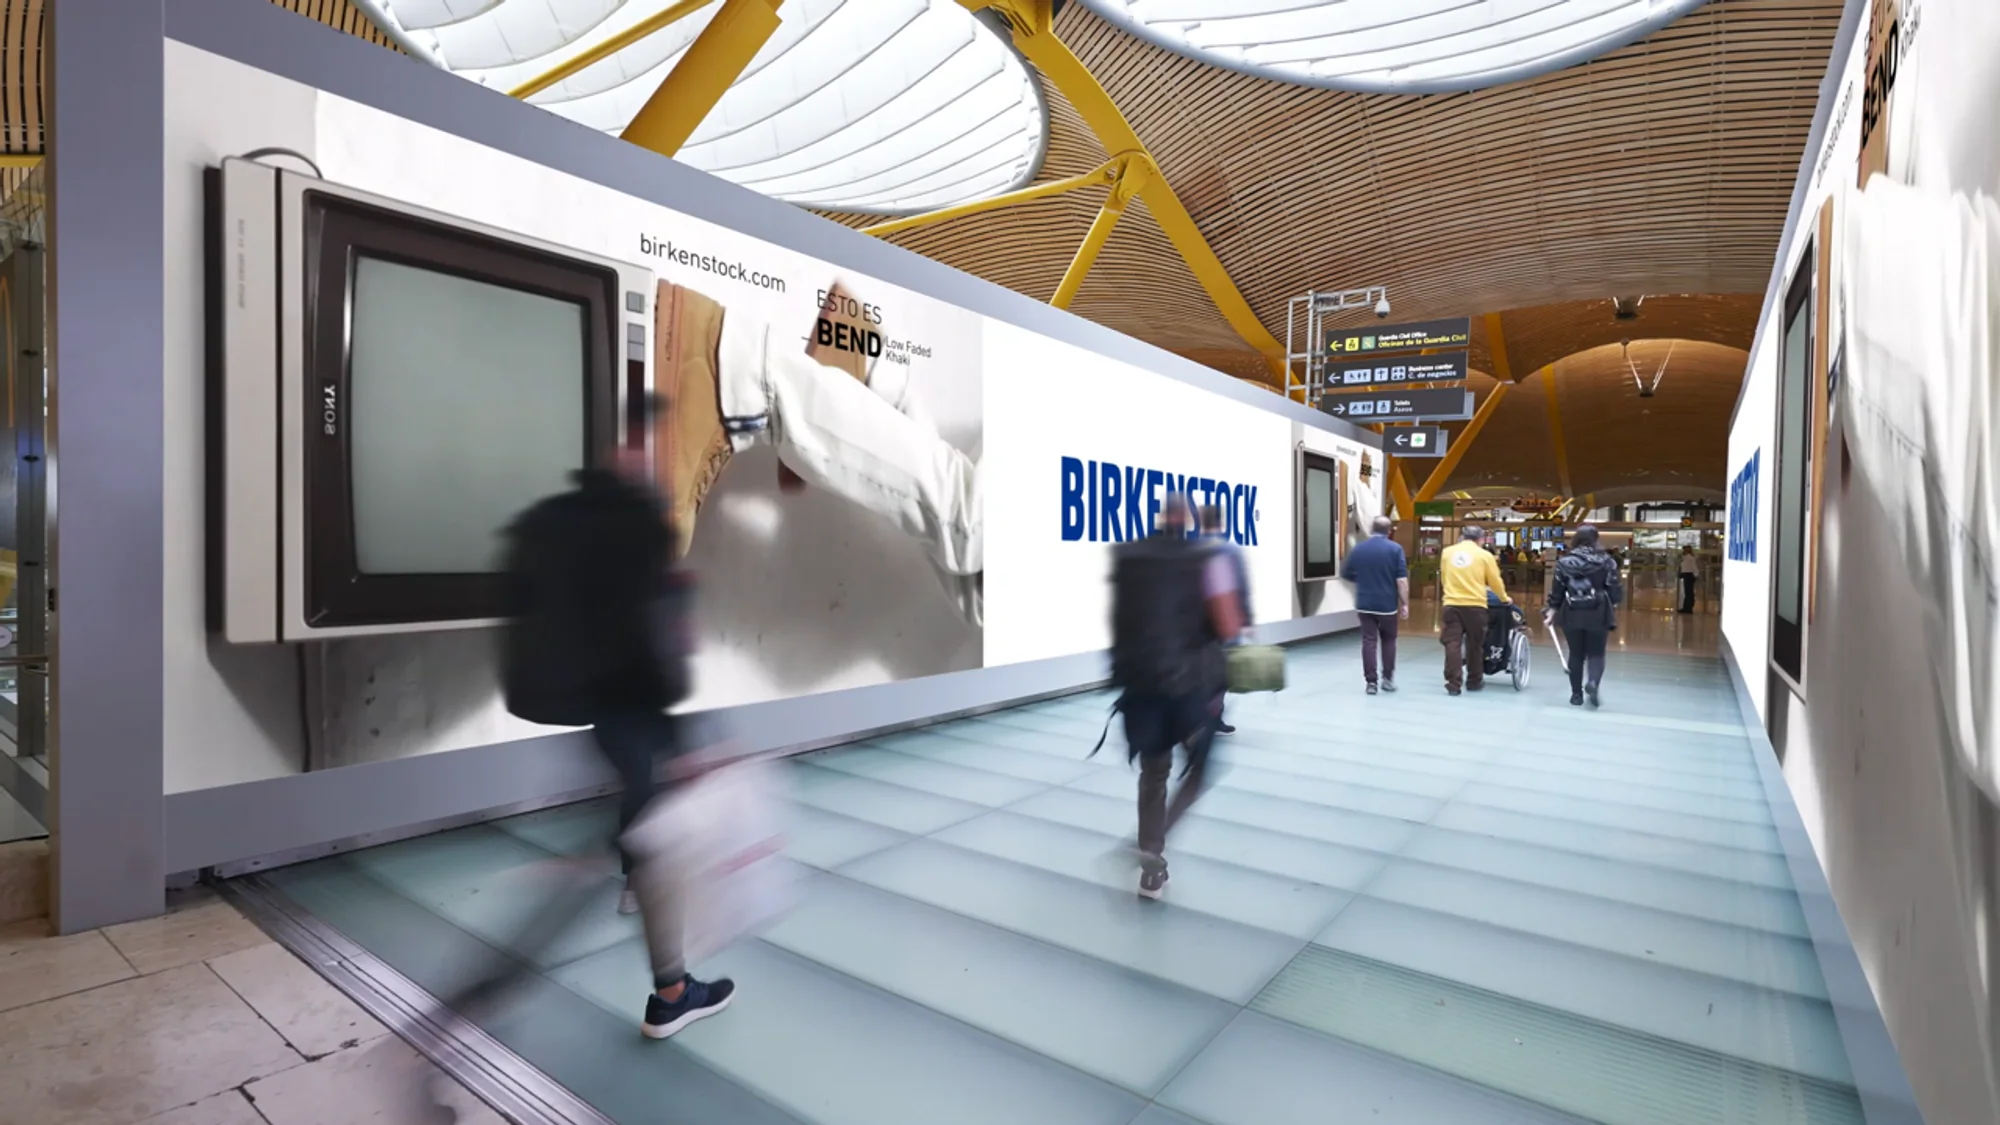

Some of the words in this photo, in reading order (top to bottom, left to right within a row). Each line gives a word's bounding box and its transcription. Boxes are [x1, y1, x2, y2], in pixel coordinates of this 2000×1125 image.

[1859, 19, 1898, 148] BEND
[641, 233, 786, 293] birkenstock.com
[817, 289, 858, 318] ESTO
[863, 303, 882, 325] ES
[817, 317, 881, 358] BEND
[885, 336, 905, 351] Low
[905, 340, 932, 358] Faded
[1424, 336, 1450, 344] Guardia
[885, 349, 911, 366] Khaki
[1061, 456, 1257, 546] BIRKESTOCK
